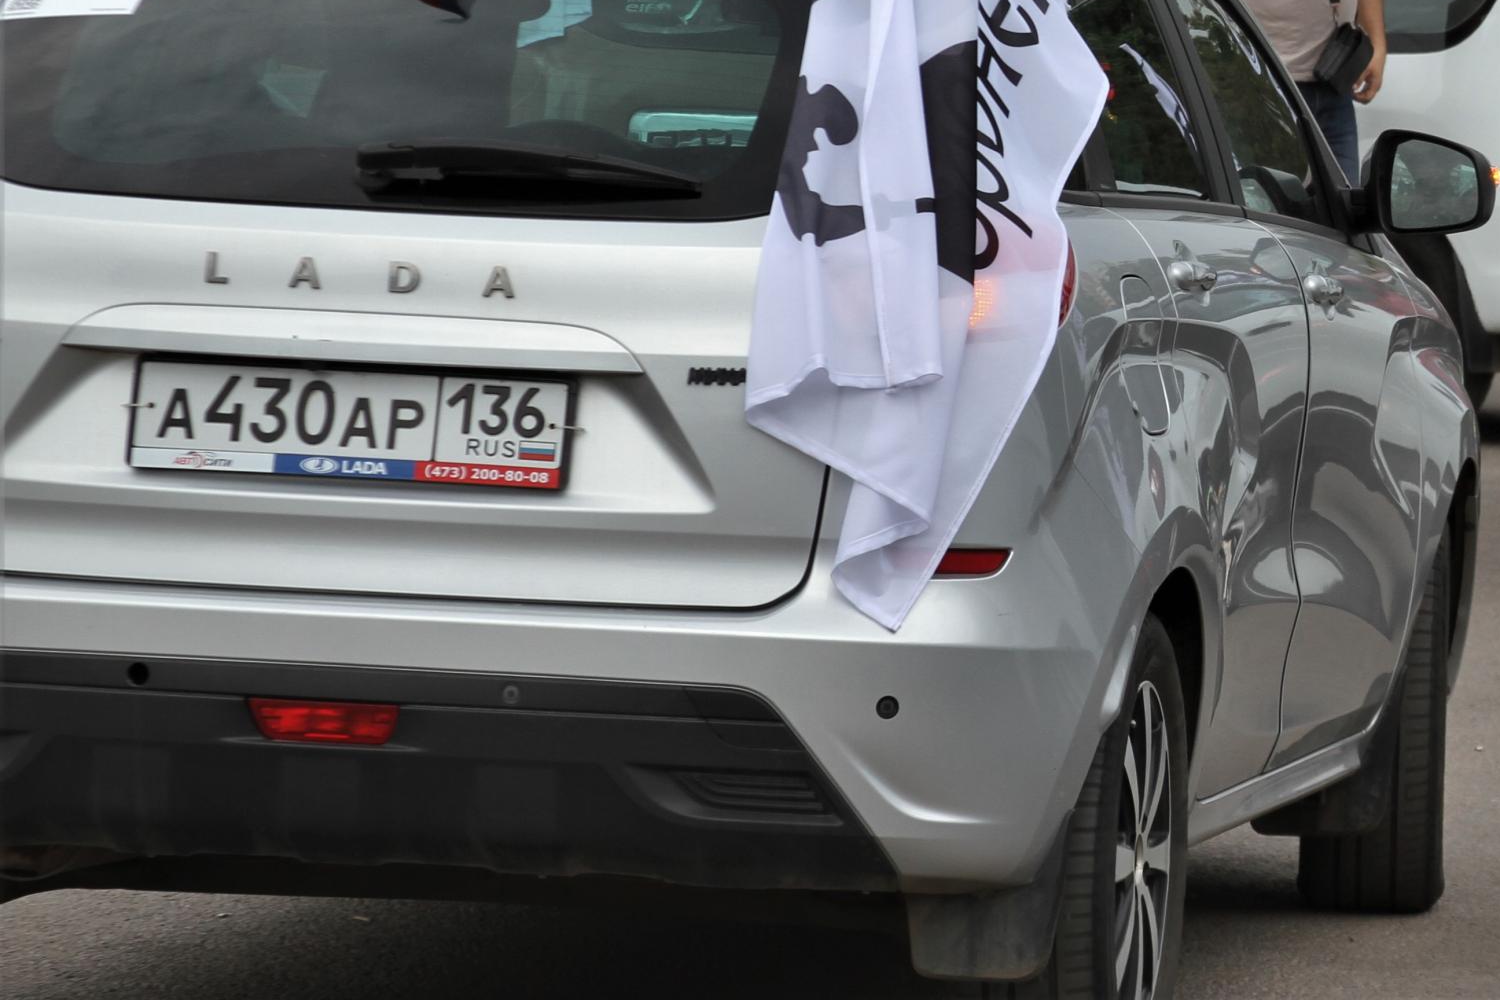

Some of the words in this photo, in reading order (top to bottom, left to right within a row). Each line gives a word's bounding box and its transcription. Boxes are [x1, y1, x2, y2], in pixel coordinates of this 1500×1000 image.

[204, 250, 516, 300] LADA
[156, 374, 425, 451] А430АР
[446, 382, 546, 438] 136
[465, 438, 516, 459] RUS
[340, 459, 388, 477] LADA
[423, 464, 467, 480] (473)
[470, 467, 549, 485] 200-80-08
